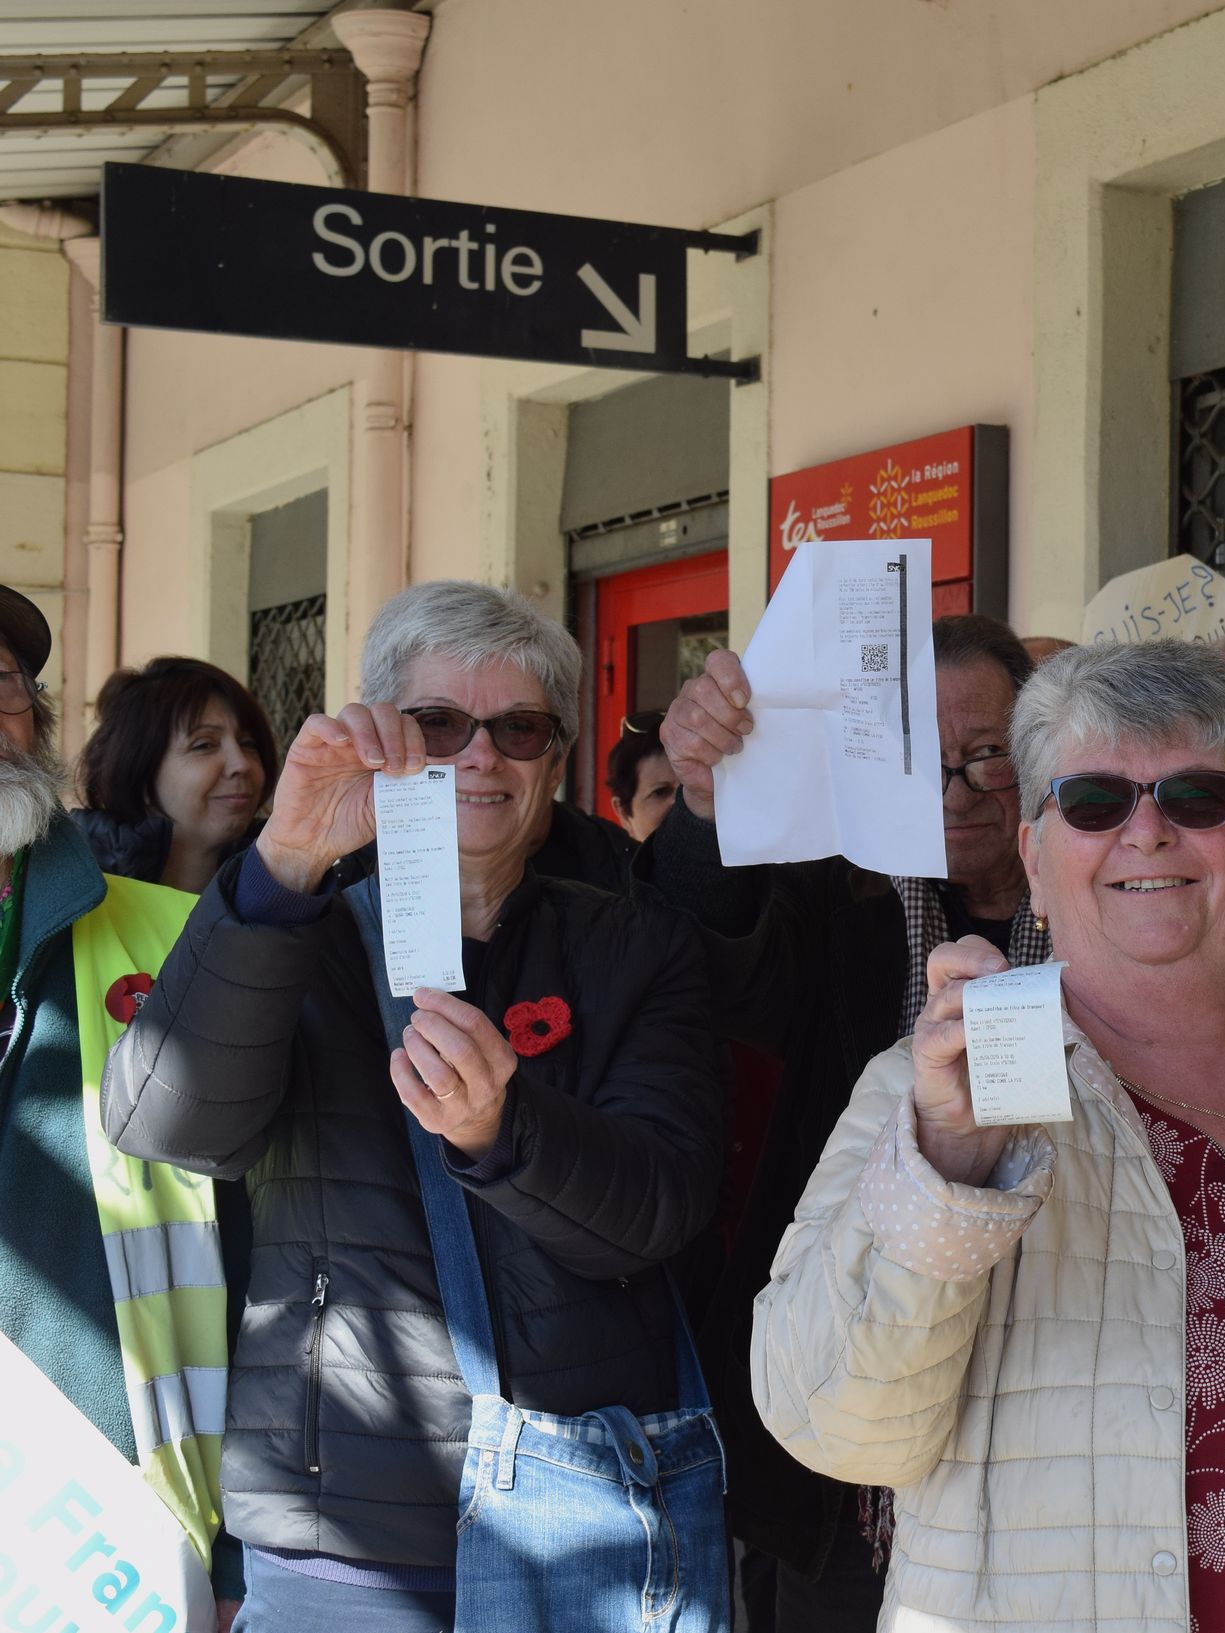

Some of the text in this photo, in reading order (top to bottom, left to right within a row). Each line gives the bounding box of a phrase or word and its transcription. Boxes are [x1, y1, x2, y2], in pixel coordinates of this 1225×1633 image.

[312, 204, 544, 296] Sortie
[911, 461, 959, 483] la Région
[911, 485, 959, 506] Languedoc
[811, 502, 847, 518] Languedoc
[911, 508, 959, 529] Roussillon
[817, 514, 851, 530] Roussillon
